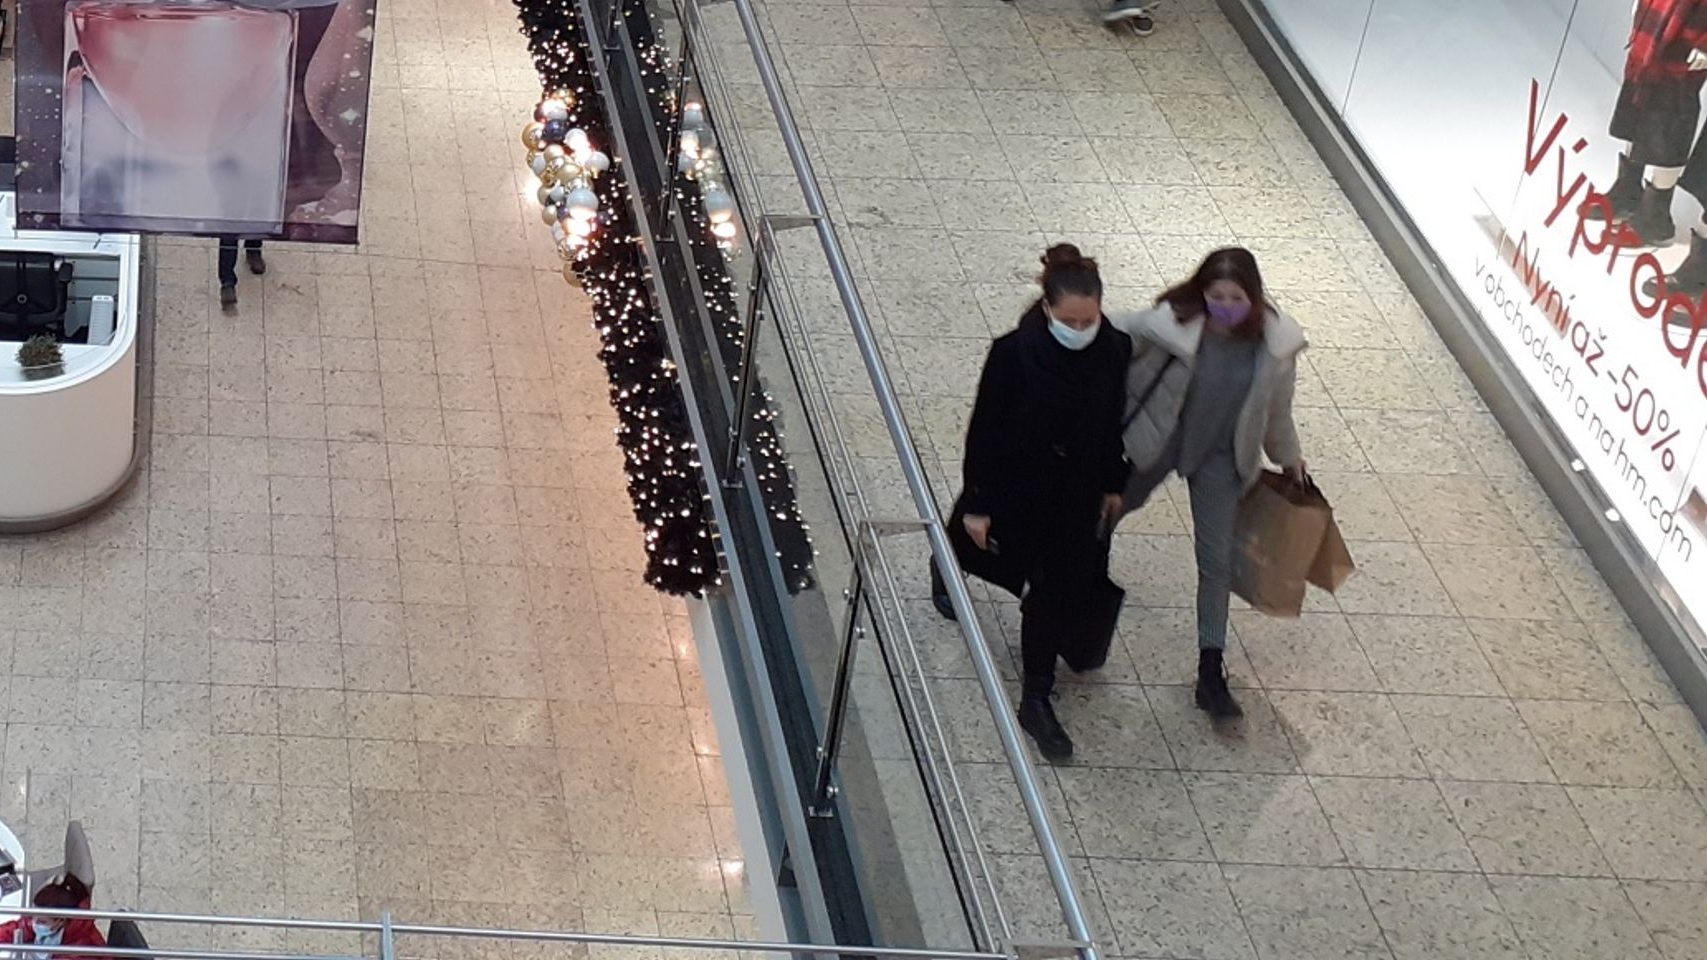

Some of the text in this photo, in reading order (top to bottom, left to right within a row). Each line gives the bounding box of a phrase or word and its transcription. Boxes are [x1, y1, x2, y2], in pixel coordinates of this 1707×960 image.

[1474, 255, 1693, 562] v obchodech a na hm.com
[1512, 230, 1681, 472] Nyní až -50%
